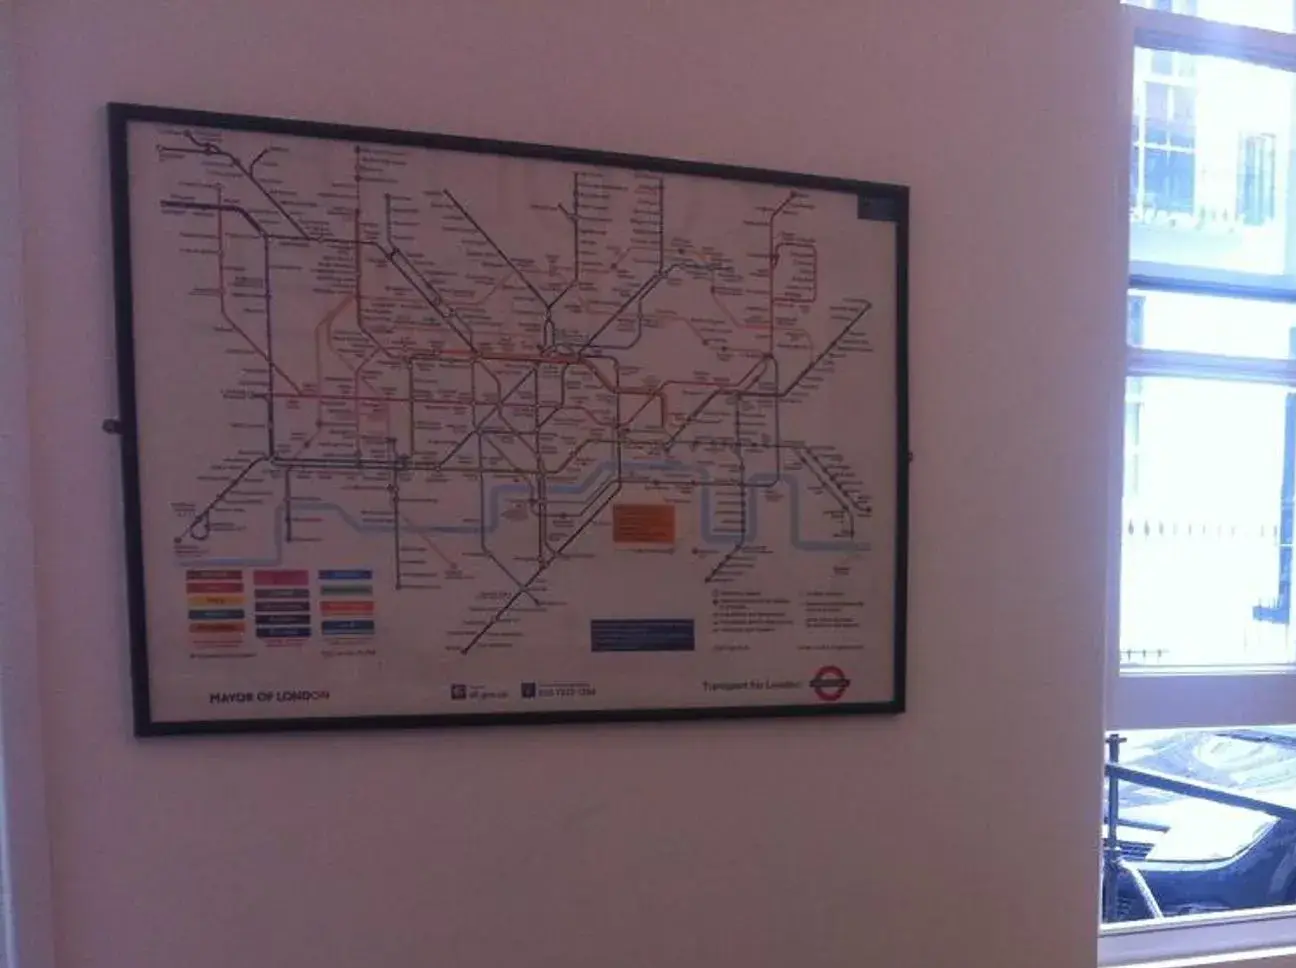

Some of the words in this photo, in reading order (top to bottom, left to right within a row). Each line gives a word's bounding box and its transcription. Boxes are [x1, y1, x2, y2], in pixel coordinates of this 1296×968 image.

[209, 692, 253, 703] MAYOR
[257, 691, 273, 702] OF
[276, 690, 330, 702] LONDON
